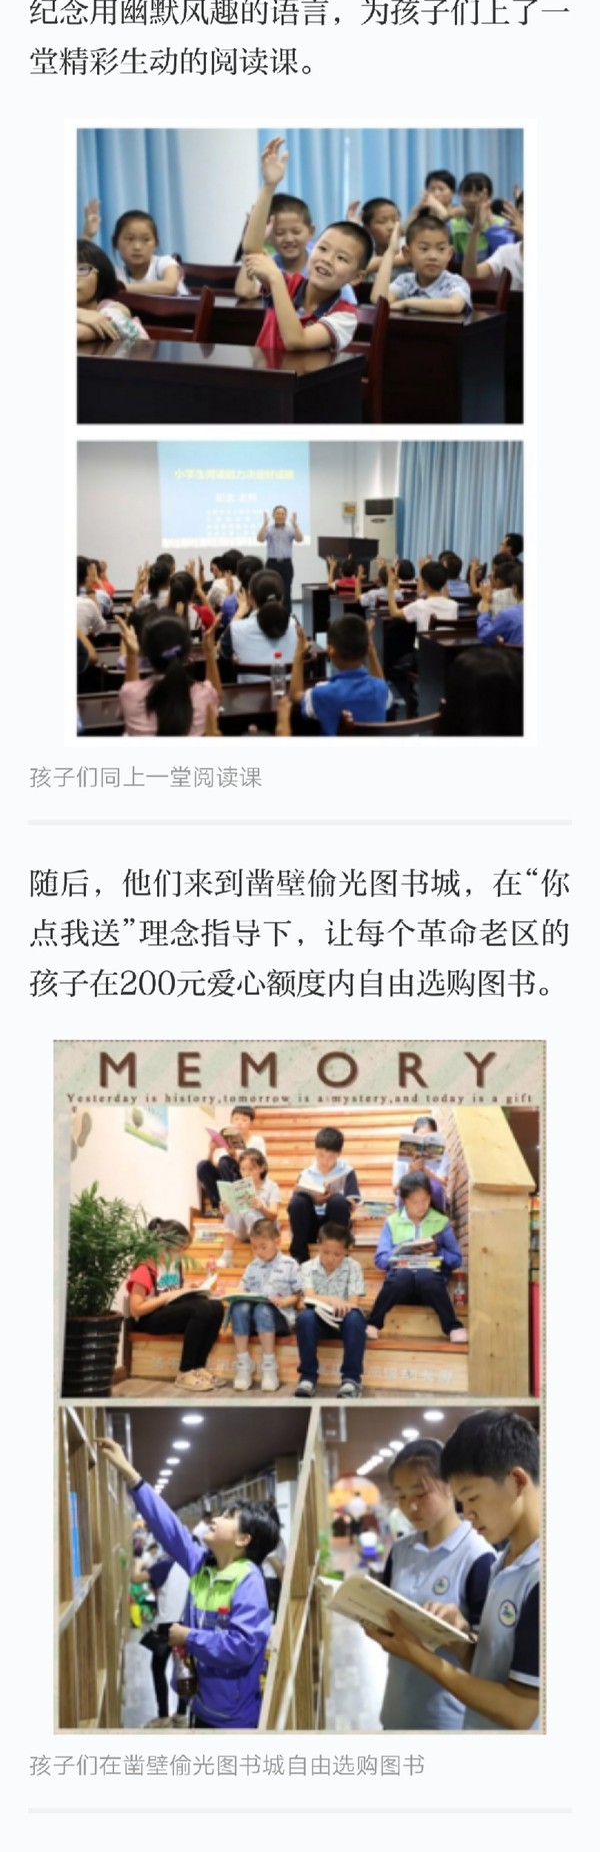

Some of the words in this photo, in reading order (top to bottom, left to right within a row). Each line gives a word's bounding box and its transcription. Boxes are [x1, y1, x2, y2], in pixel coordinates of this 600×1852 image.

[30, 47, 311, 75] 堂精彩生动的阅读课。
[30, 766, 261, 788] 孩子们同上一堂阅读课
[30, 918, 569, 947] 点我送”理念指导下，让每个革命老区的
[30, 968, 548, 997] 孩子在200元爱心额度内自由选购图书。
[30, 1754, 424, 1776] 孩子们在凿壁偷光图书城自由选购图书
